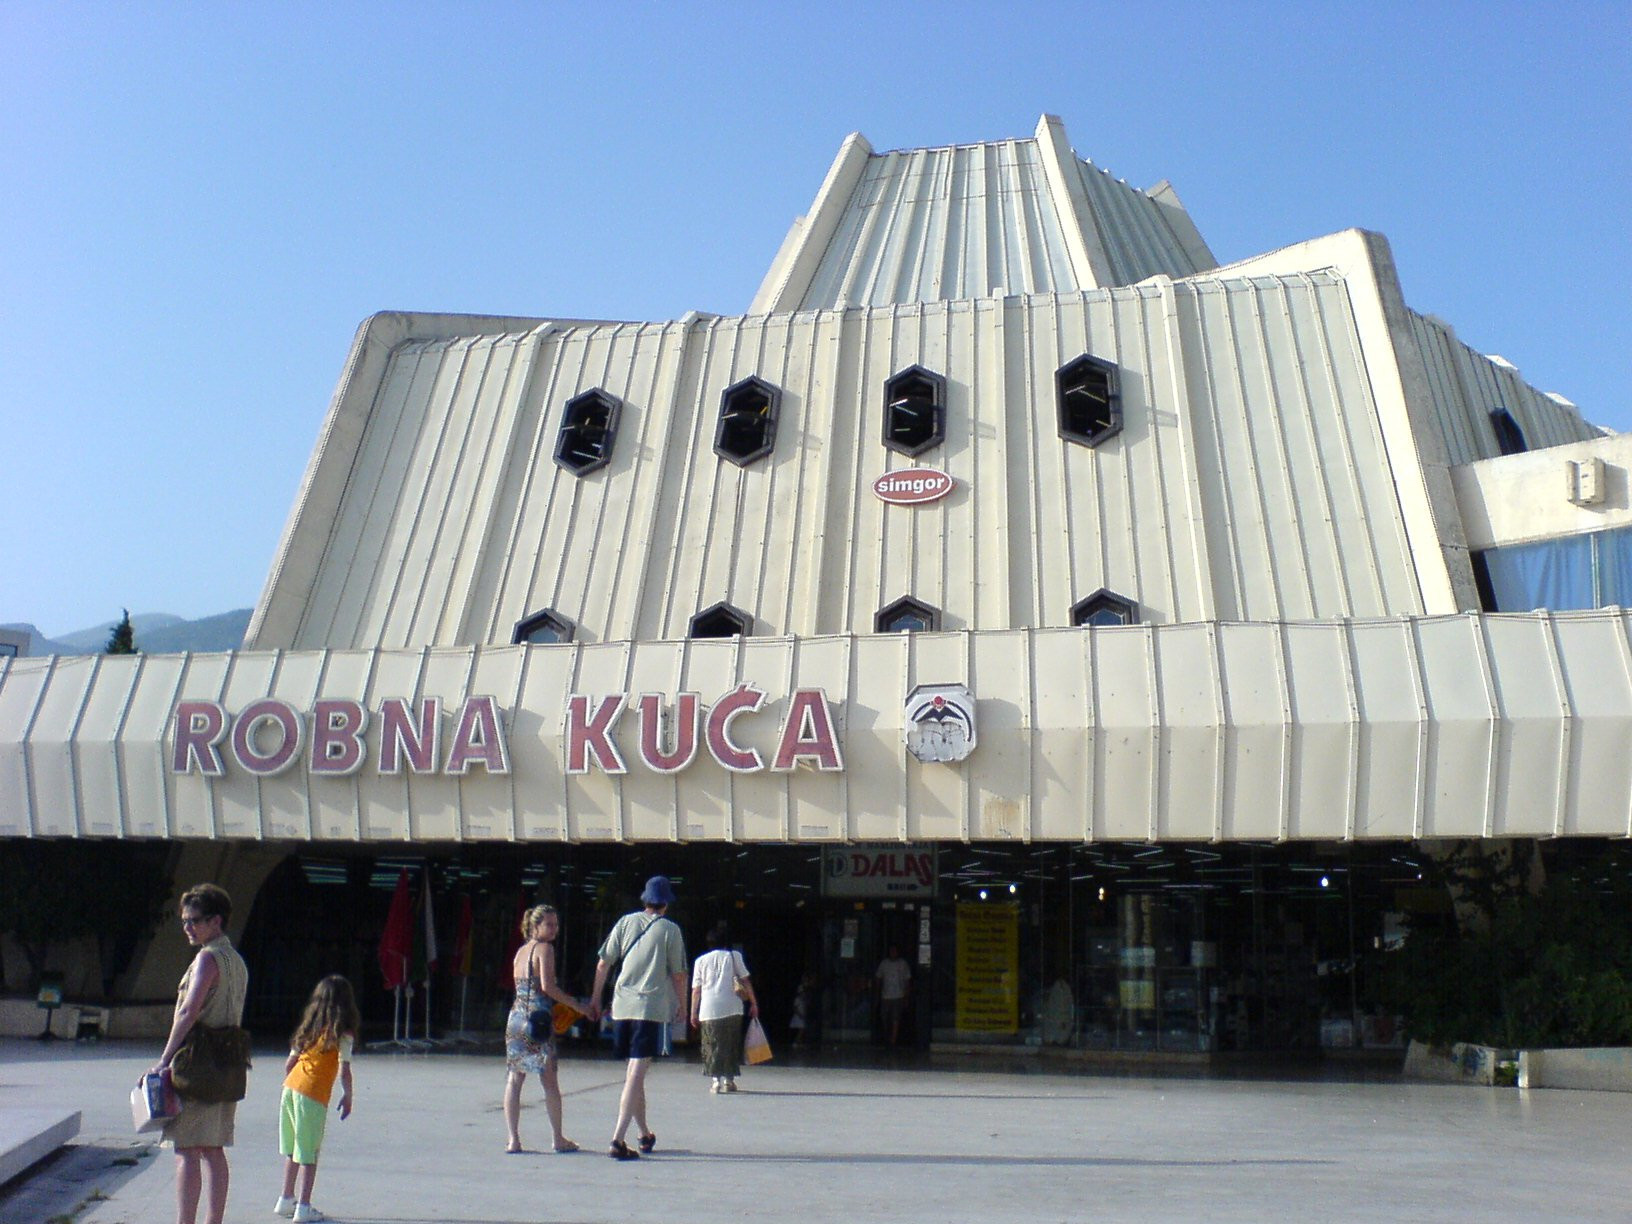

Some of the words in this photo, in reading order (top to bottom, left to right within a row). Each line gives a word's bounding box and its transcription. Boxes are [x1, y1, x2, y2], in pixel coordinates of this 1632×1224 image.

[878, 477, 945, 494] simgor
[173, 696, 511, 776] ROBNA
[851, 852, 933, 886] DALAS
